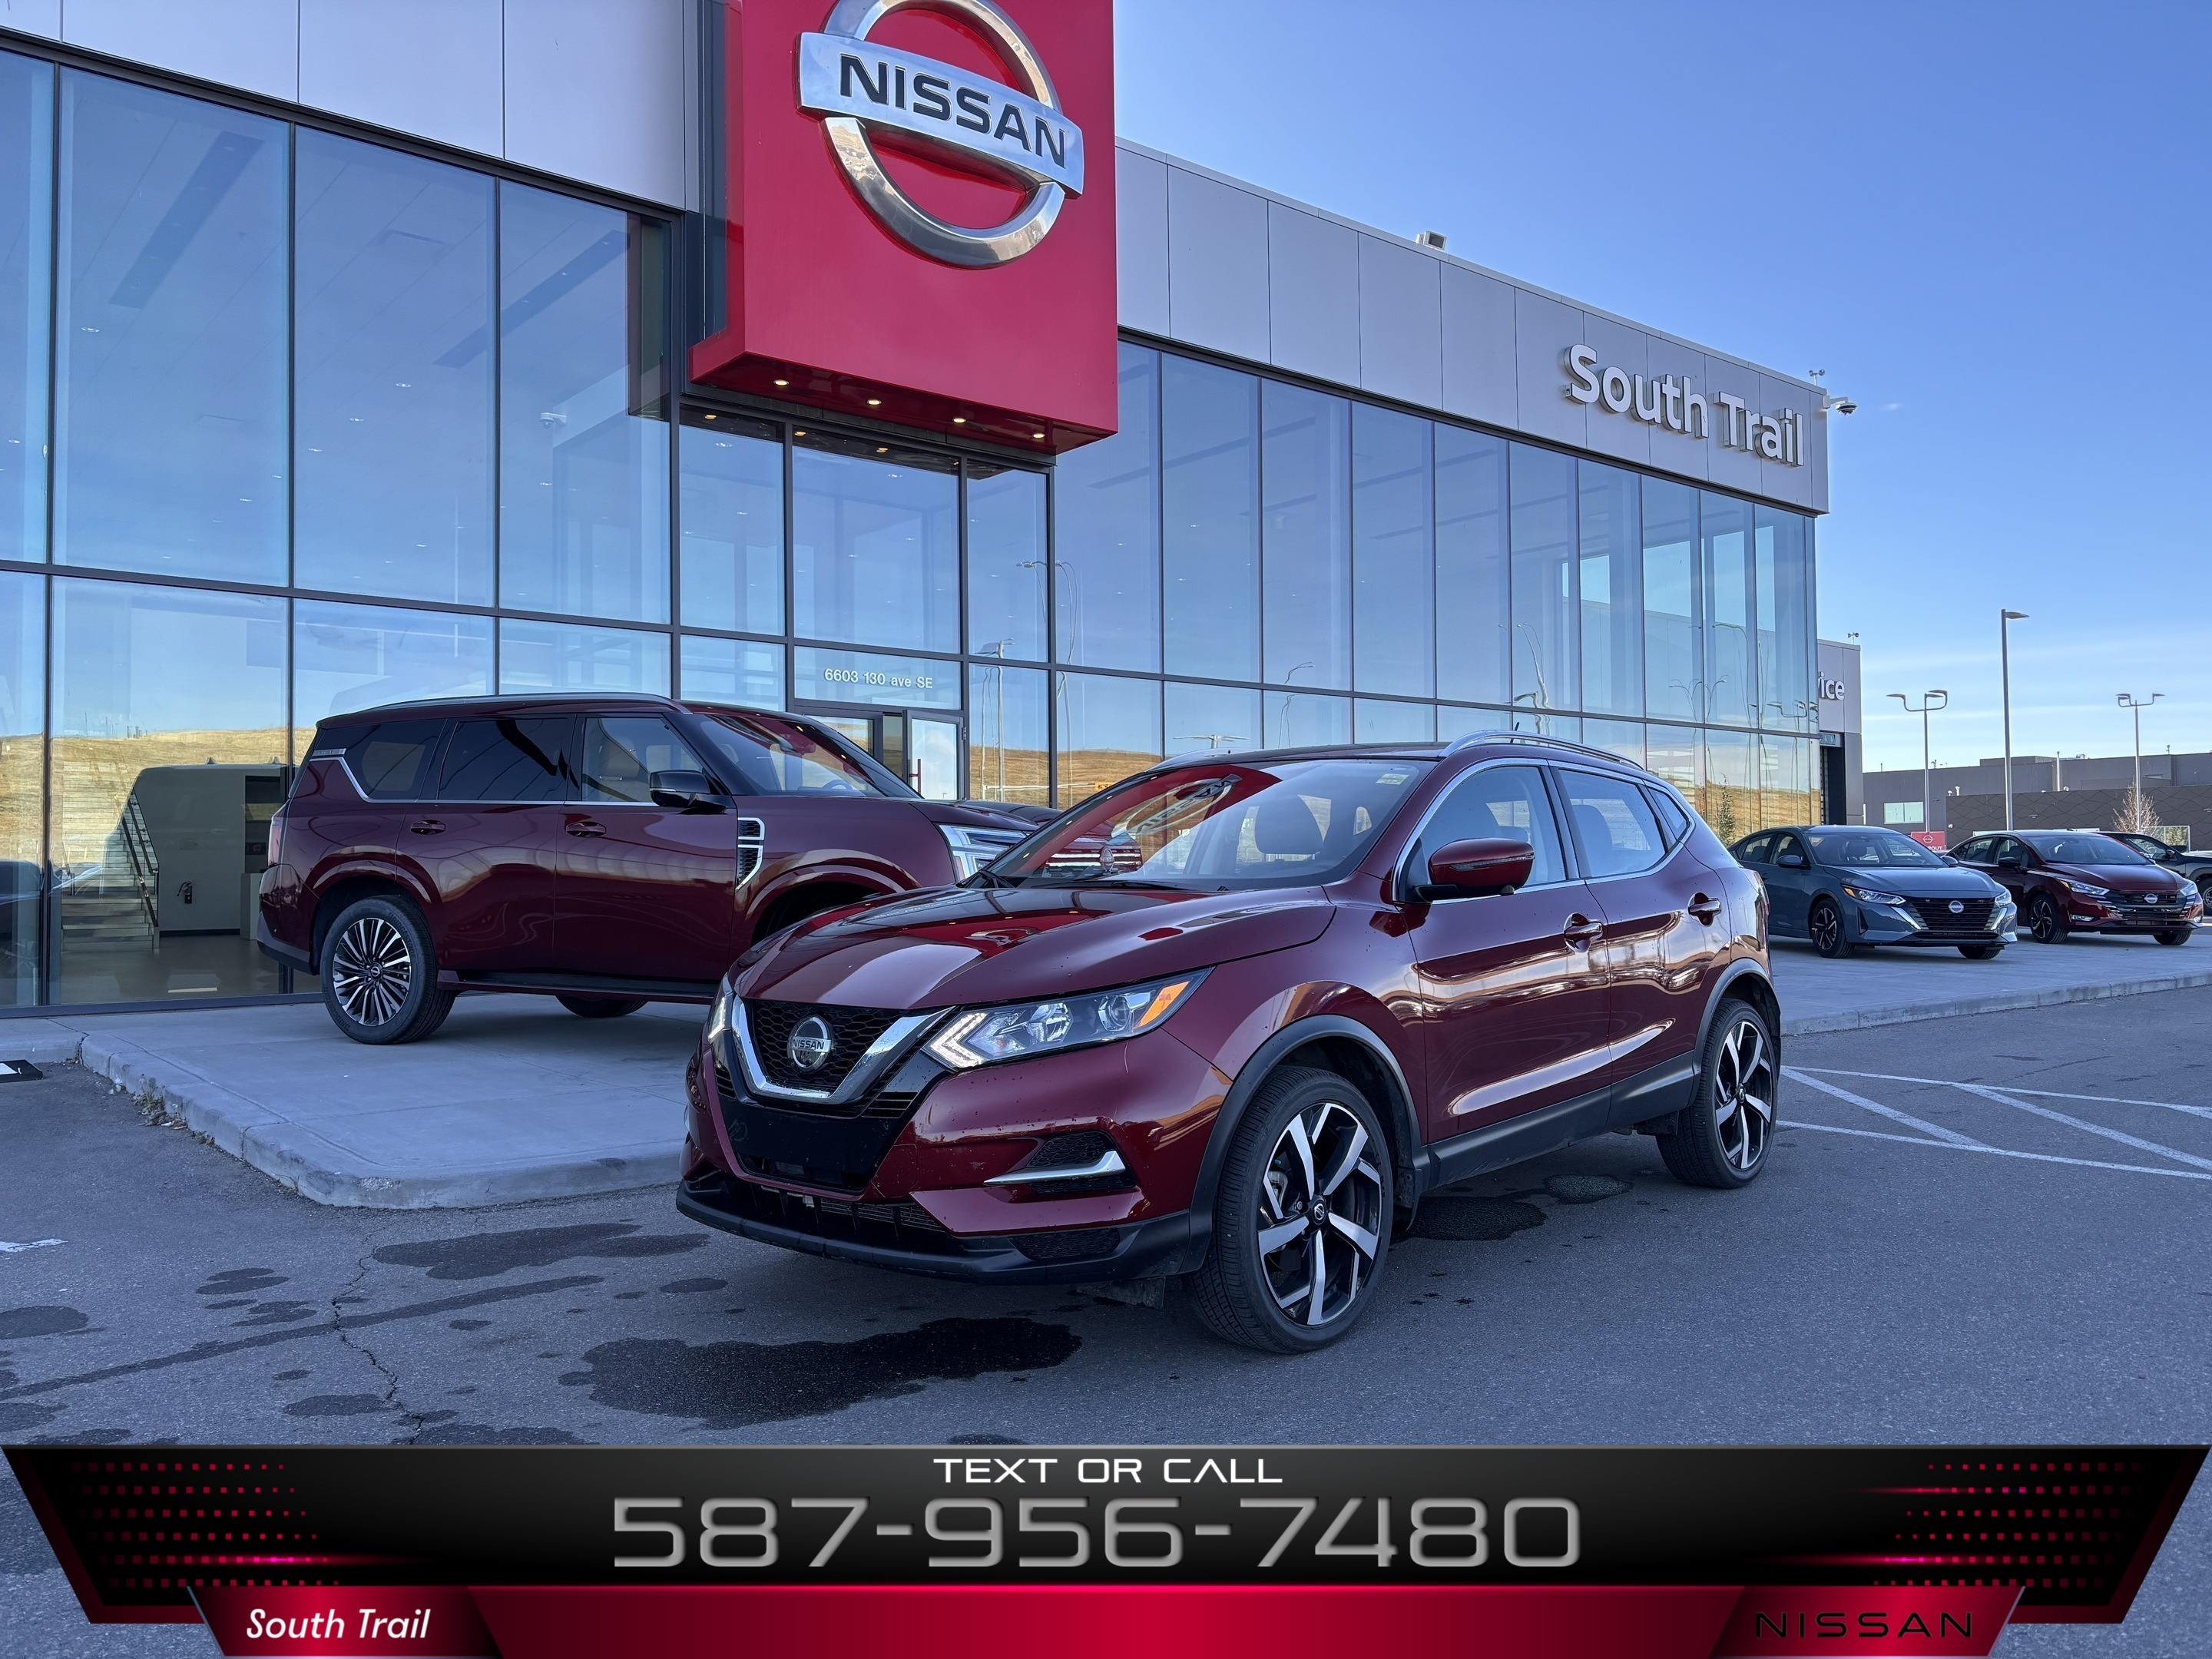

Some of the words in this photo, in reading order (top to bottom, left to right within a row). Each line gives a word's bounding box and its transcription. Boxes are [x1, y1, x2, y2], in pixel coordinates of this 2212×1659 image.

[839, 53, 1066, 170] NISSAN
[1567, 344, 1709, 439] South
[1715, 391, 1804, 466] Trail
[824, 668, 859, 684] 6603
[863, 672, 886, 685] 130
[890, 677, 912, 687] ave
[916, 676, 933, 689] SE
[792, 1038, 825, 1050] NISSAN
